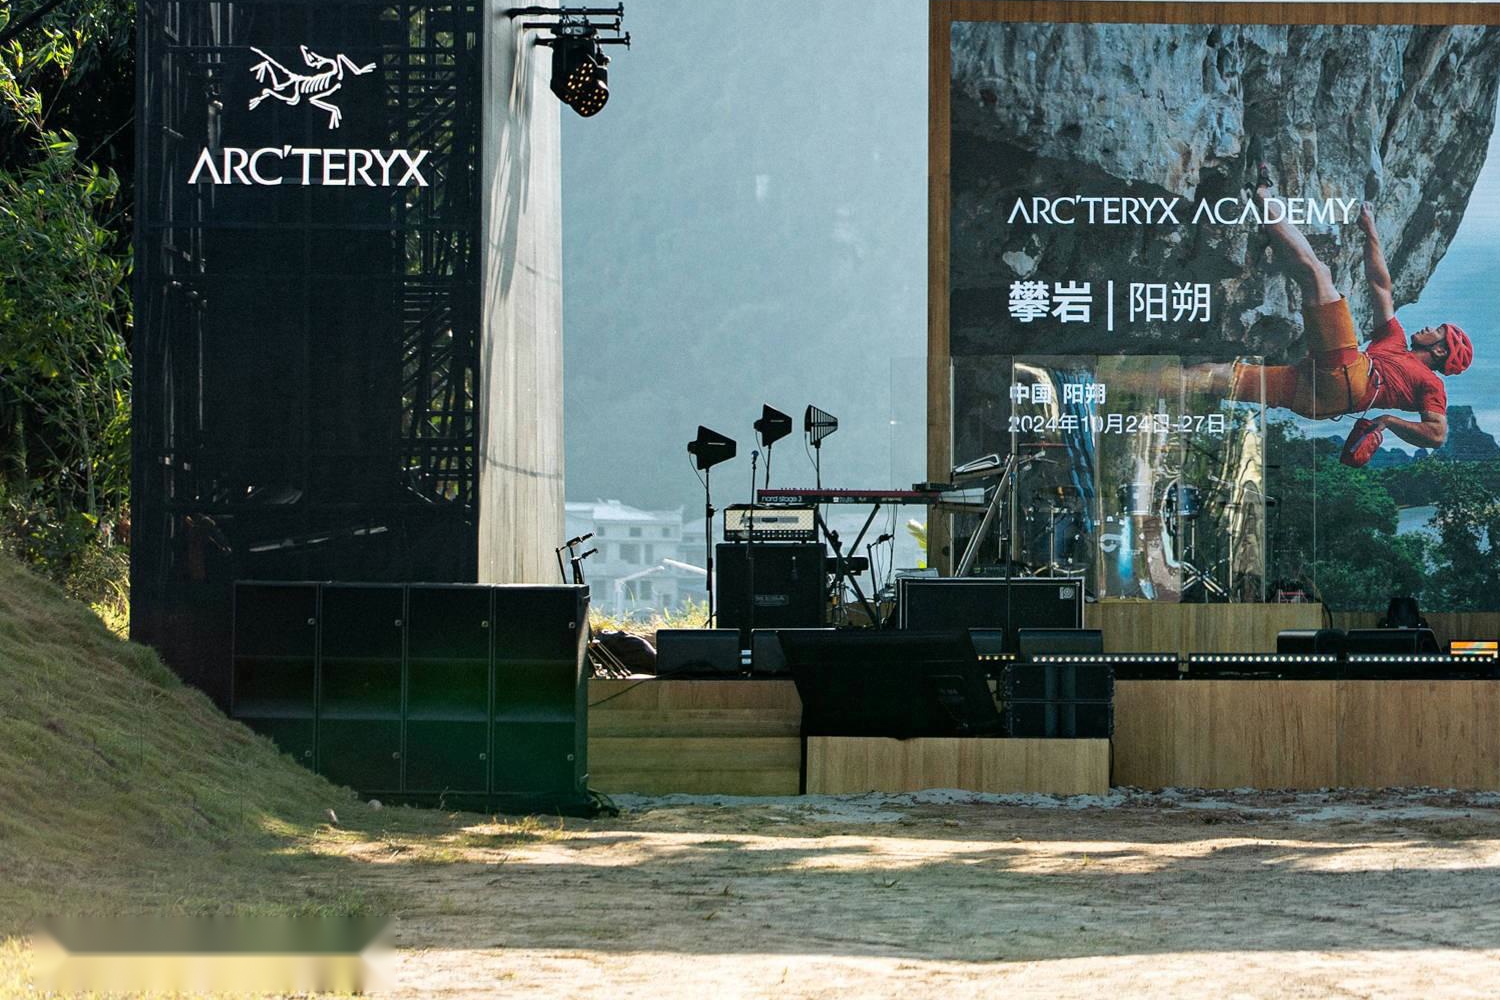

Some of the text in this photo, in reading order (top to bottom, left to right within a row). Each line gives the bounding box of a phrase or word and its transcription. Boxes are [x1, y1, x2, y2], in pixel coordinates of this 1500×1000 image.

[188, 145, 430, 187] ARC'TERYX
[1007, 195, 1357, 225] ARC'TERYX ACADEMY
[1008, 281, 1092, 323] 攀岩
[1128, 282, 1211, 322] 阳朔
[1009, 383, 1106, 405] 中国 阳朔
